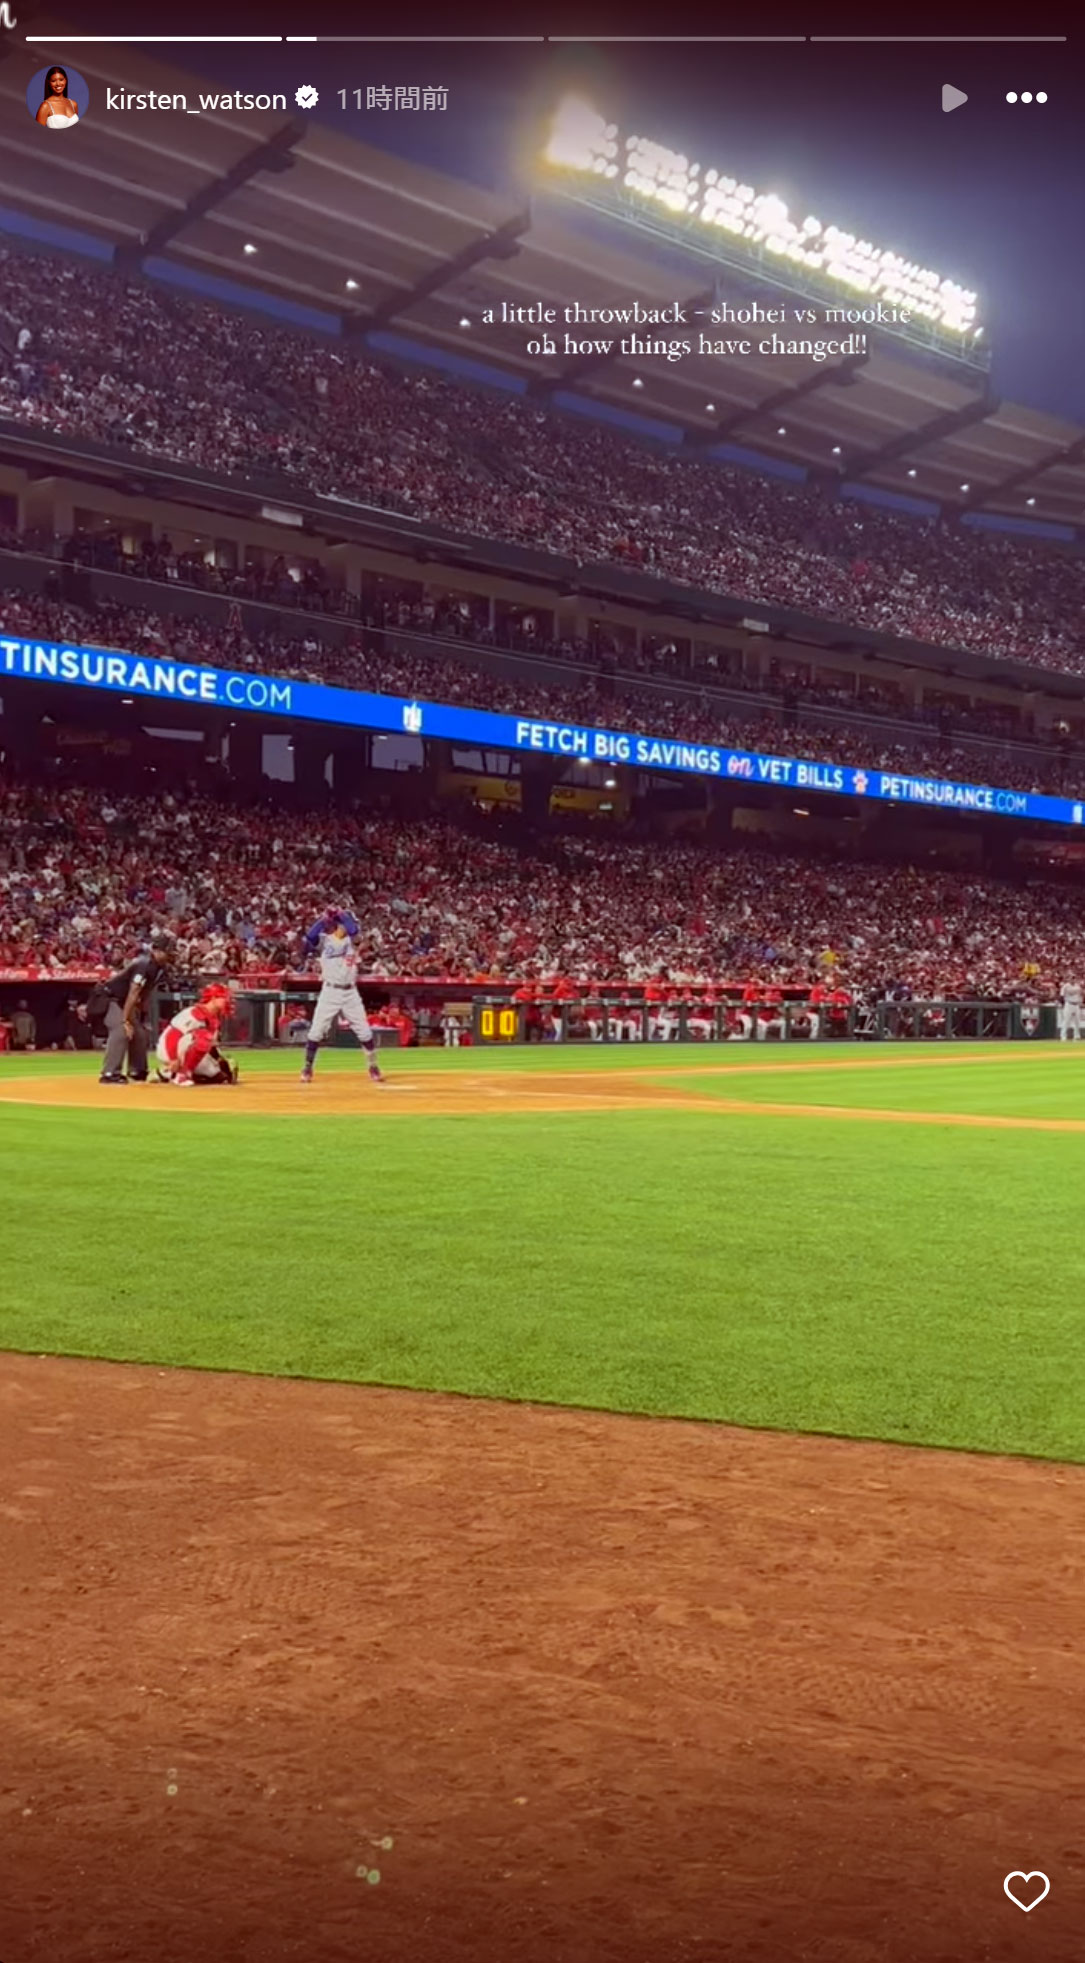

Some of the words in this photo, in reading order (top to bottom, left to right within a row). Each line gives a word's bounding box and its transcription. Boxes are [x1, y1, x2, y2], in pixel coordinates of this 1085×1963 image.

[0, 640, 292, 710] TINSURANCE.COM
[516, 722, 587, 753] FETCH
[595, 734, 630, 759] BIG
[637, 740, 721, 772] SAVINGS
[727, 756, 754, 778] on
[758, 758, 792, 781] VET
[796, 764, 844, 789] BILLS
[880, 776, 1027, 812] PETINSURANCE.COM
